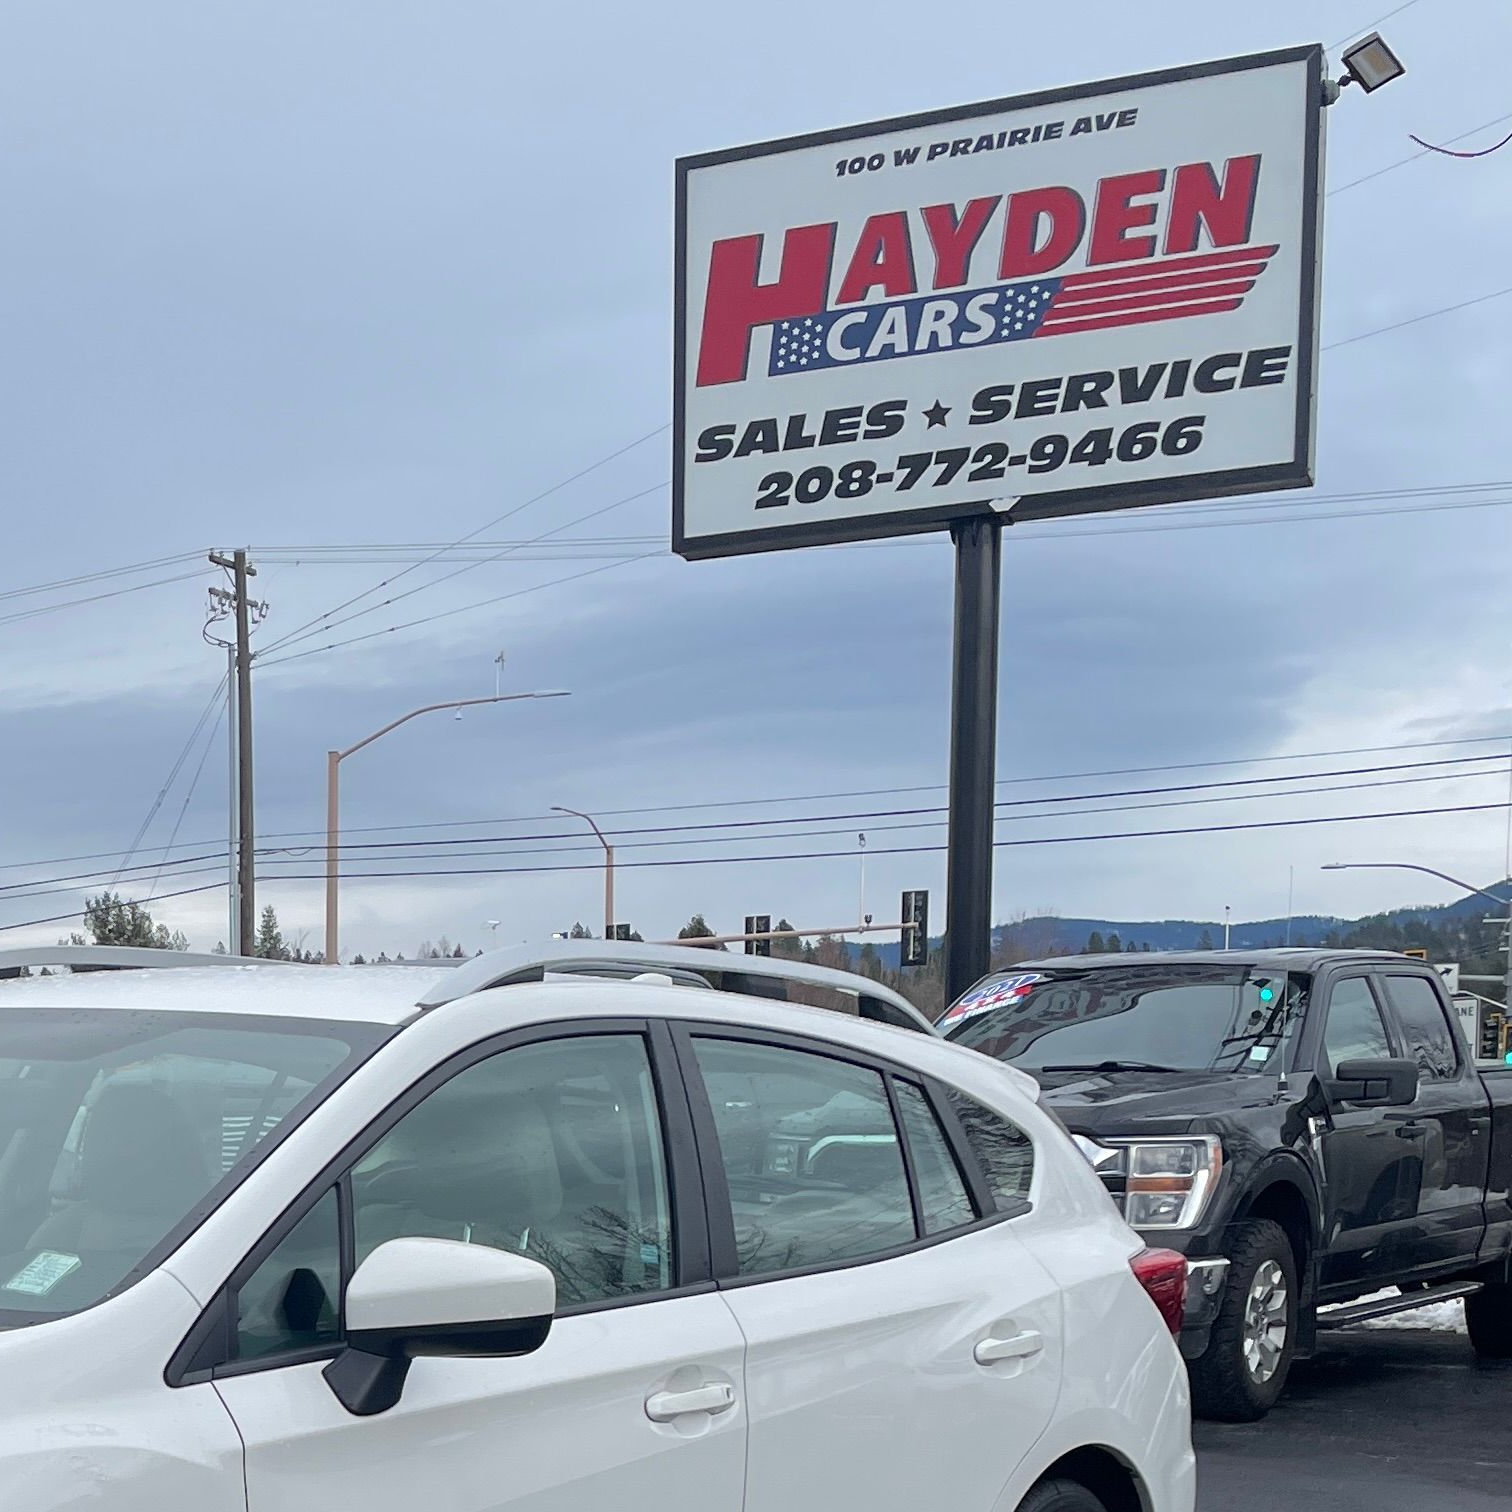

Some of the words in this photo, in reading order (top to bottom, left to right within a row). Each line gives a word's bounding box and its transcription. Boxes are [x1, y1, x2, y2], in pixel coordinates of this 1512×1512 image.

[835, 153, 885, 177] 100
[893, 147, 921, 167] W
[926, 121, 1065, 161] PRAIRIE
[1069, 108, 1139, 137] AVE
[695, 154, 1262, 388] HAYDEN
[825, 291, 1000, 363] CARS
[694, 400, 908, 463] SALES
[968, 345, 1292, 425] SERVICE
[754, 415, 1206, 509] 208-772-9466
